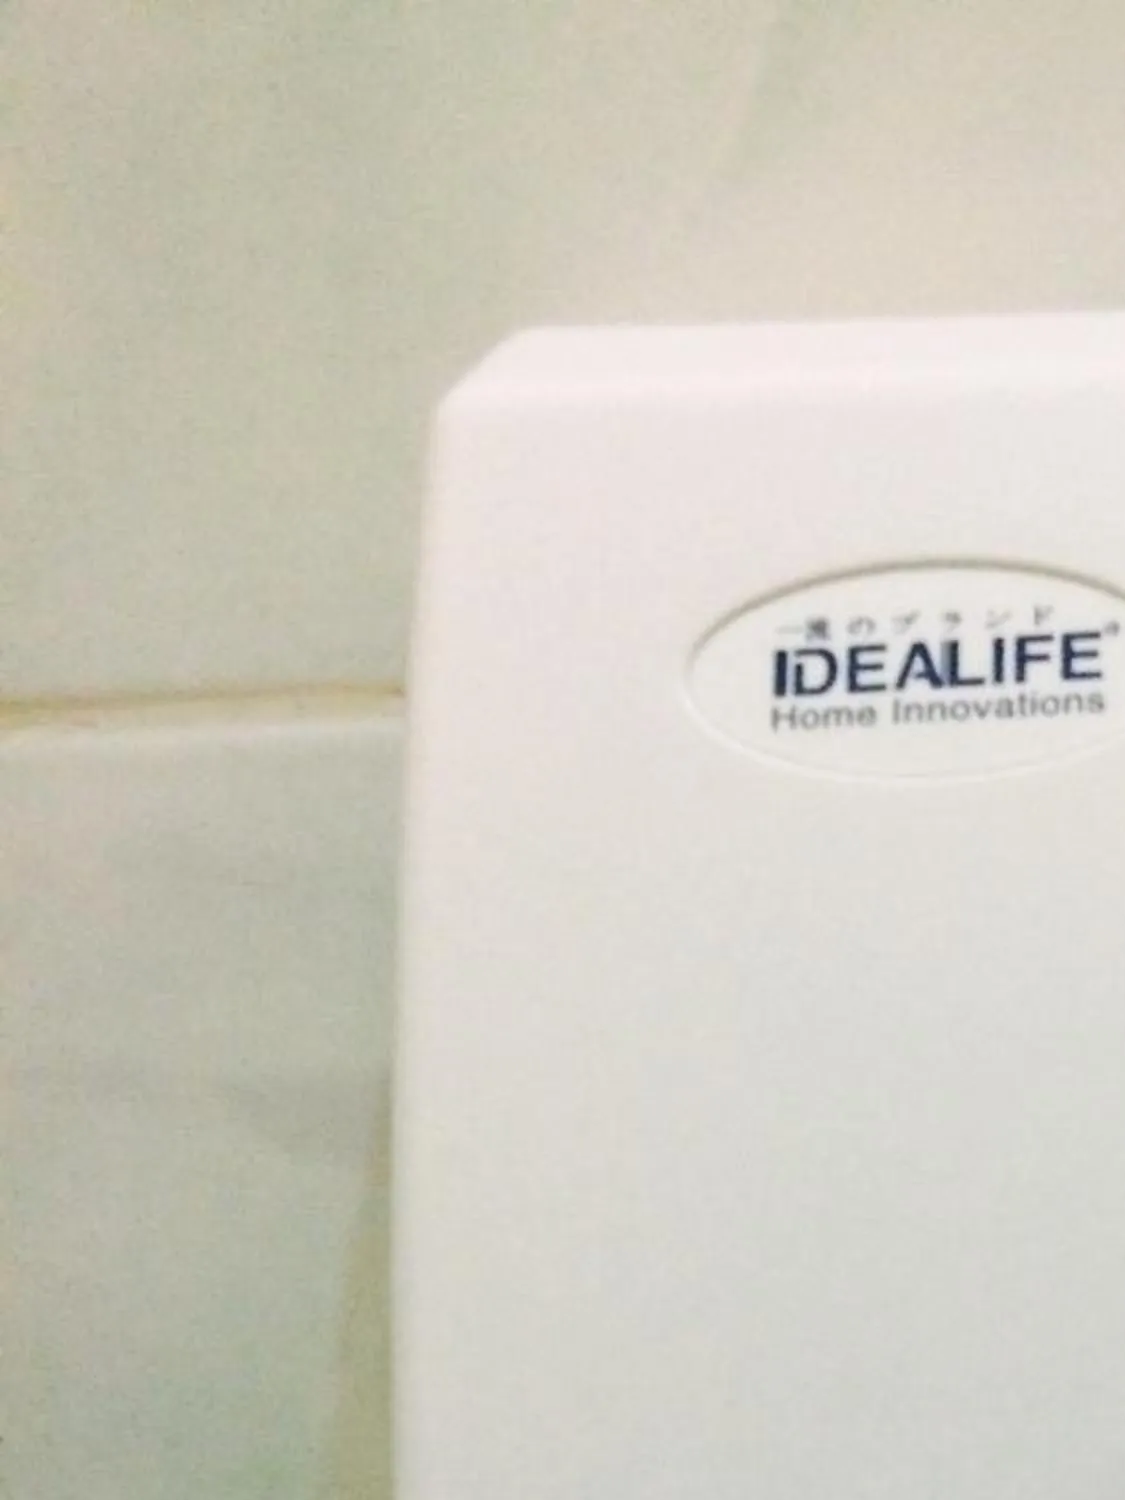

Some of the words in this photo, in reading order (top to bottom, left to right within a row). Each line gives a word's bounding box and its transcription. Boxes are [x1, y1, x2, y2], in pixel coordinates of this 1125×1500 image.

[773, 631, 1104, 697] IDEALIFE
[771, 700, 878, 732] Home
[893, 690, 1107, 725] Innovations
